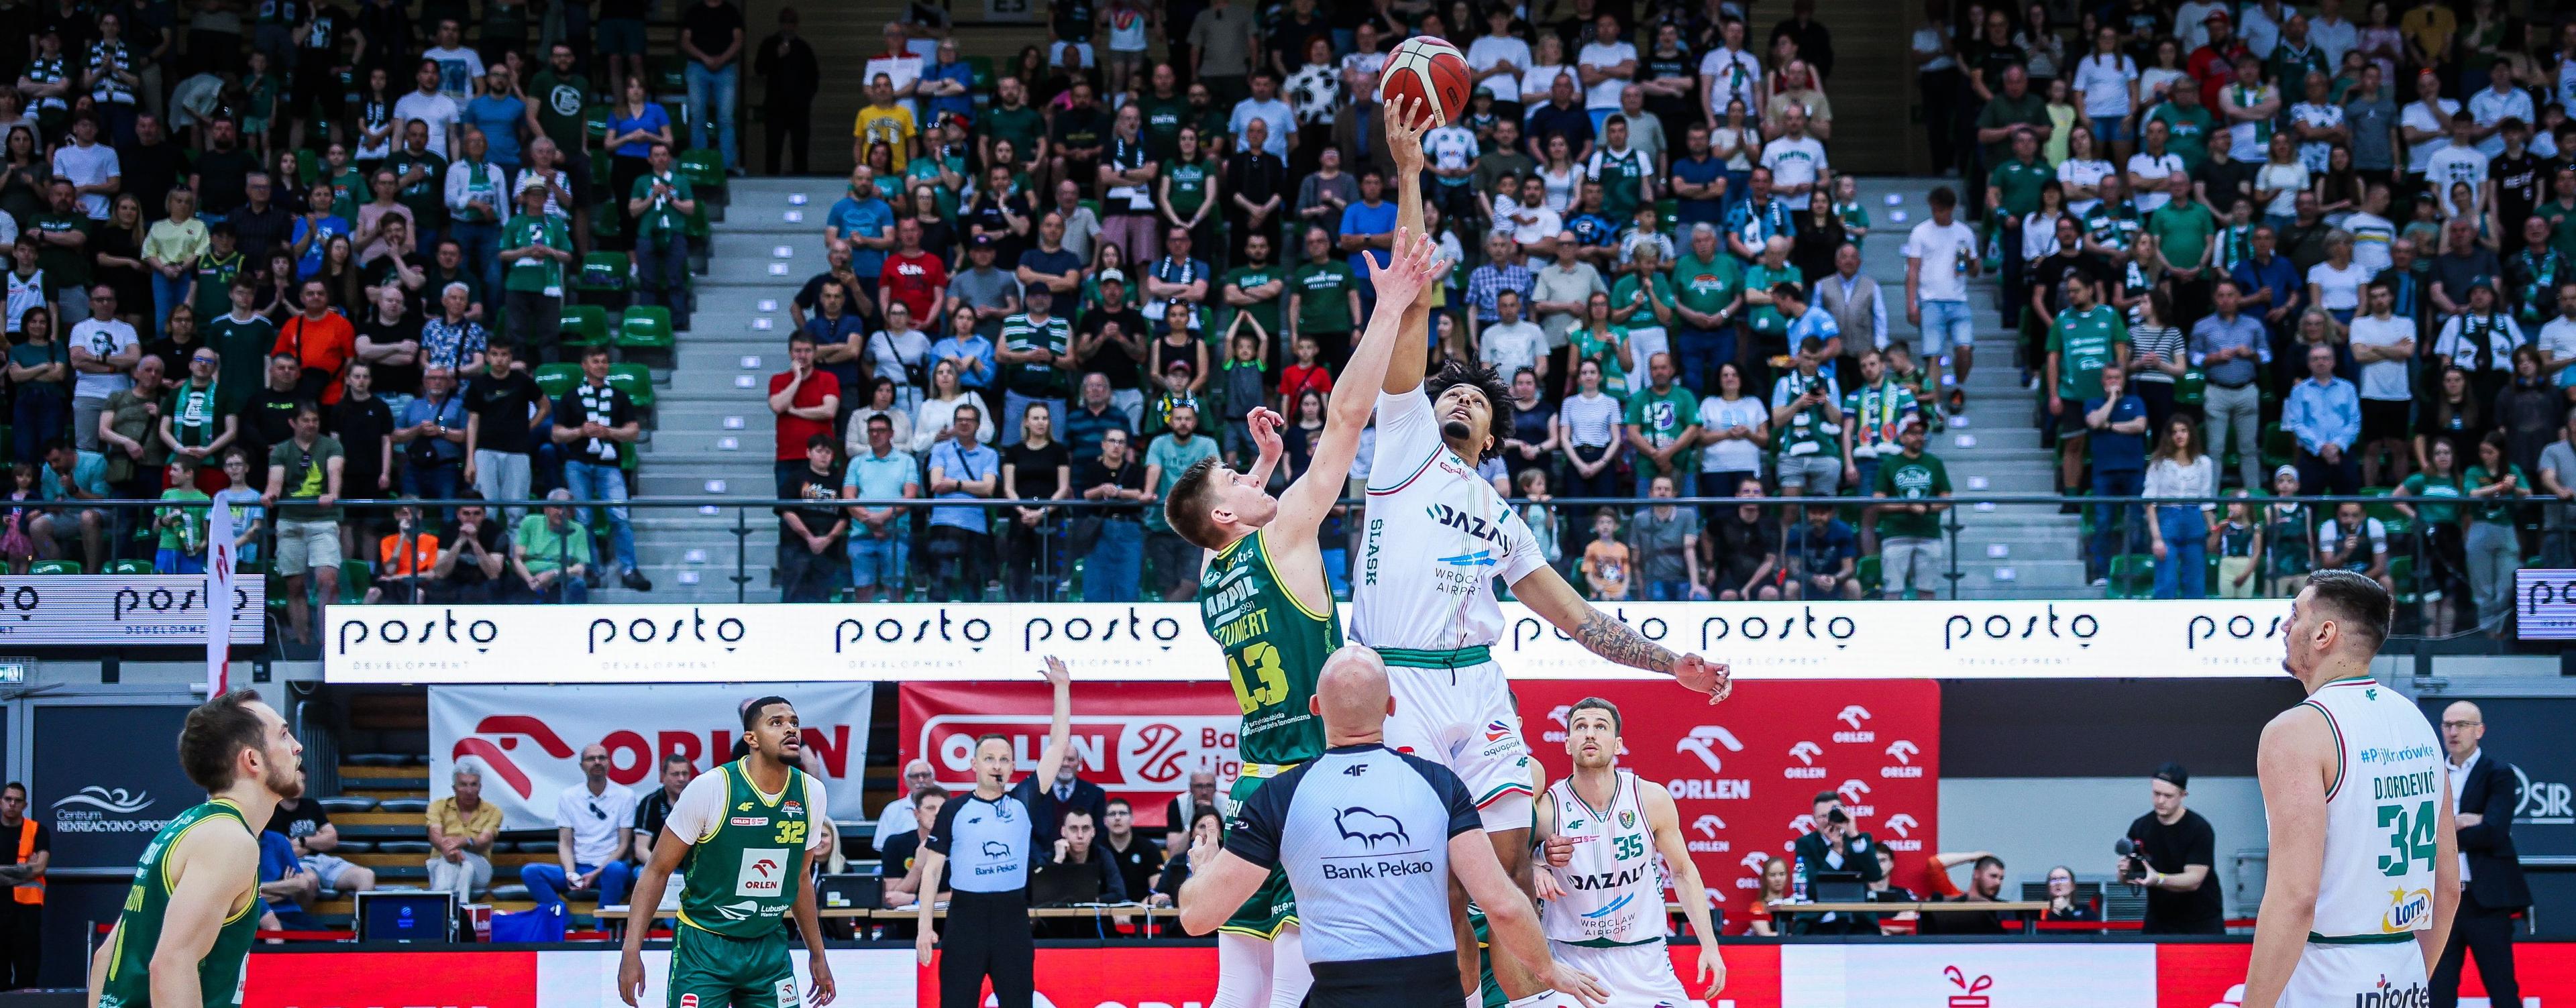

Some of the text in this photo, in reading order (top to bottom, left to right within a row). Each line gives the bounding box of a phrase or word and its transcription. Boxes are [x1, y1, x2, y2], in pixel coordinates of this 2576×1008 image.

[1366, 518, 1384, 586] ŚLĄSK
[1206, 575, 1259, 618] ARPOL
[339, 609, 497, 655] posto
[590, 608, 745, 654] posto
[836, 609, 991, 653] posto
[1025, 607, 1179, 651] posto
[1703, 606, 1856, 651] posto
[1945, 604, 2098, 649] posto
[2189, 615, 2281, 649] pos
[1226, 641, 1289, 716] 13
[1483, 739, 1521, 757] aquapark
[1832, 731, 1875, 743] ORLEN
[600, 726, 850, 785] ORLN
[1343, 764, 1369, 777] 4F
[1784, 767, 1827, 779] ORLEN
[1880, 766, 1923, 778] ORLEN
[1667, 779, 1751, 800] ORLEN
[56, 809, 102, 821] Centrum
[737, 802, 755, 811] 4F
[1566, 801, 1572, 812] C
[774, 820, 806, 844] 32
[1567, 819, 1585, 829] 4F
[1613, 833, 1644, 861] 35
[1688, 840, 1730, 852] ORLEN
[2377, 801, 2436, 877] 34
[975, 866, 995, 876] Bank
[1322, 859, 1434, 879] Bank Pekao
[1570, 862, 1646, 891] BAZALT
[745, 881, 777, 889] ORLEN
[2395, 896, 2425, 926] LOTTO
[1585, 923, 1633, 937] AIRPORT
[782, 995, 797, 1004] ORLEN
